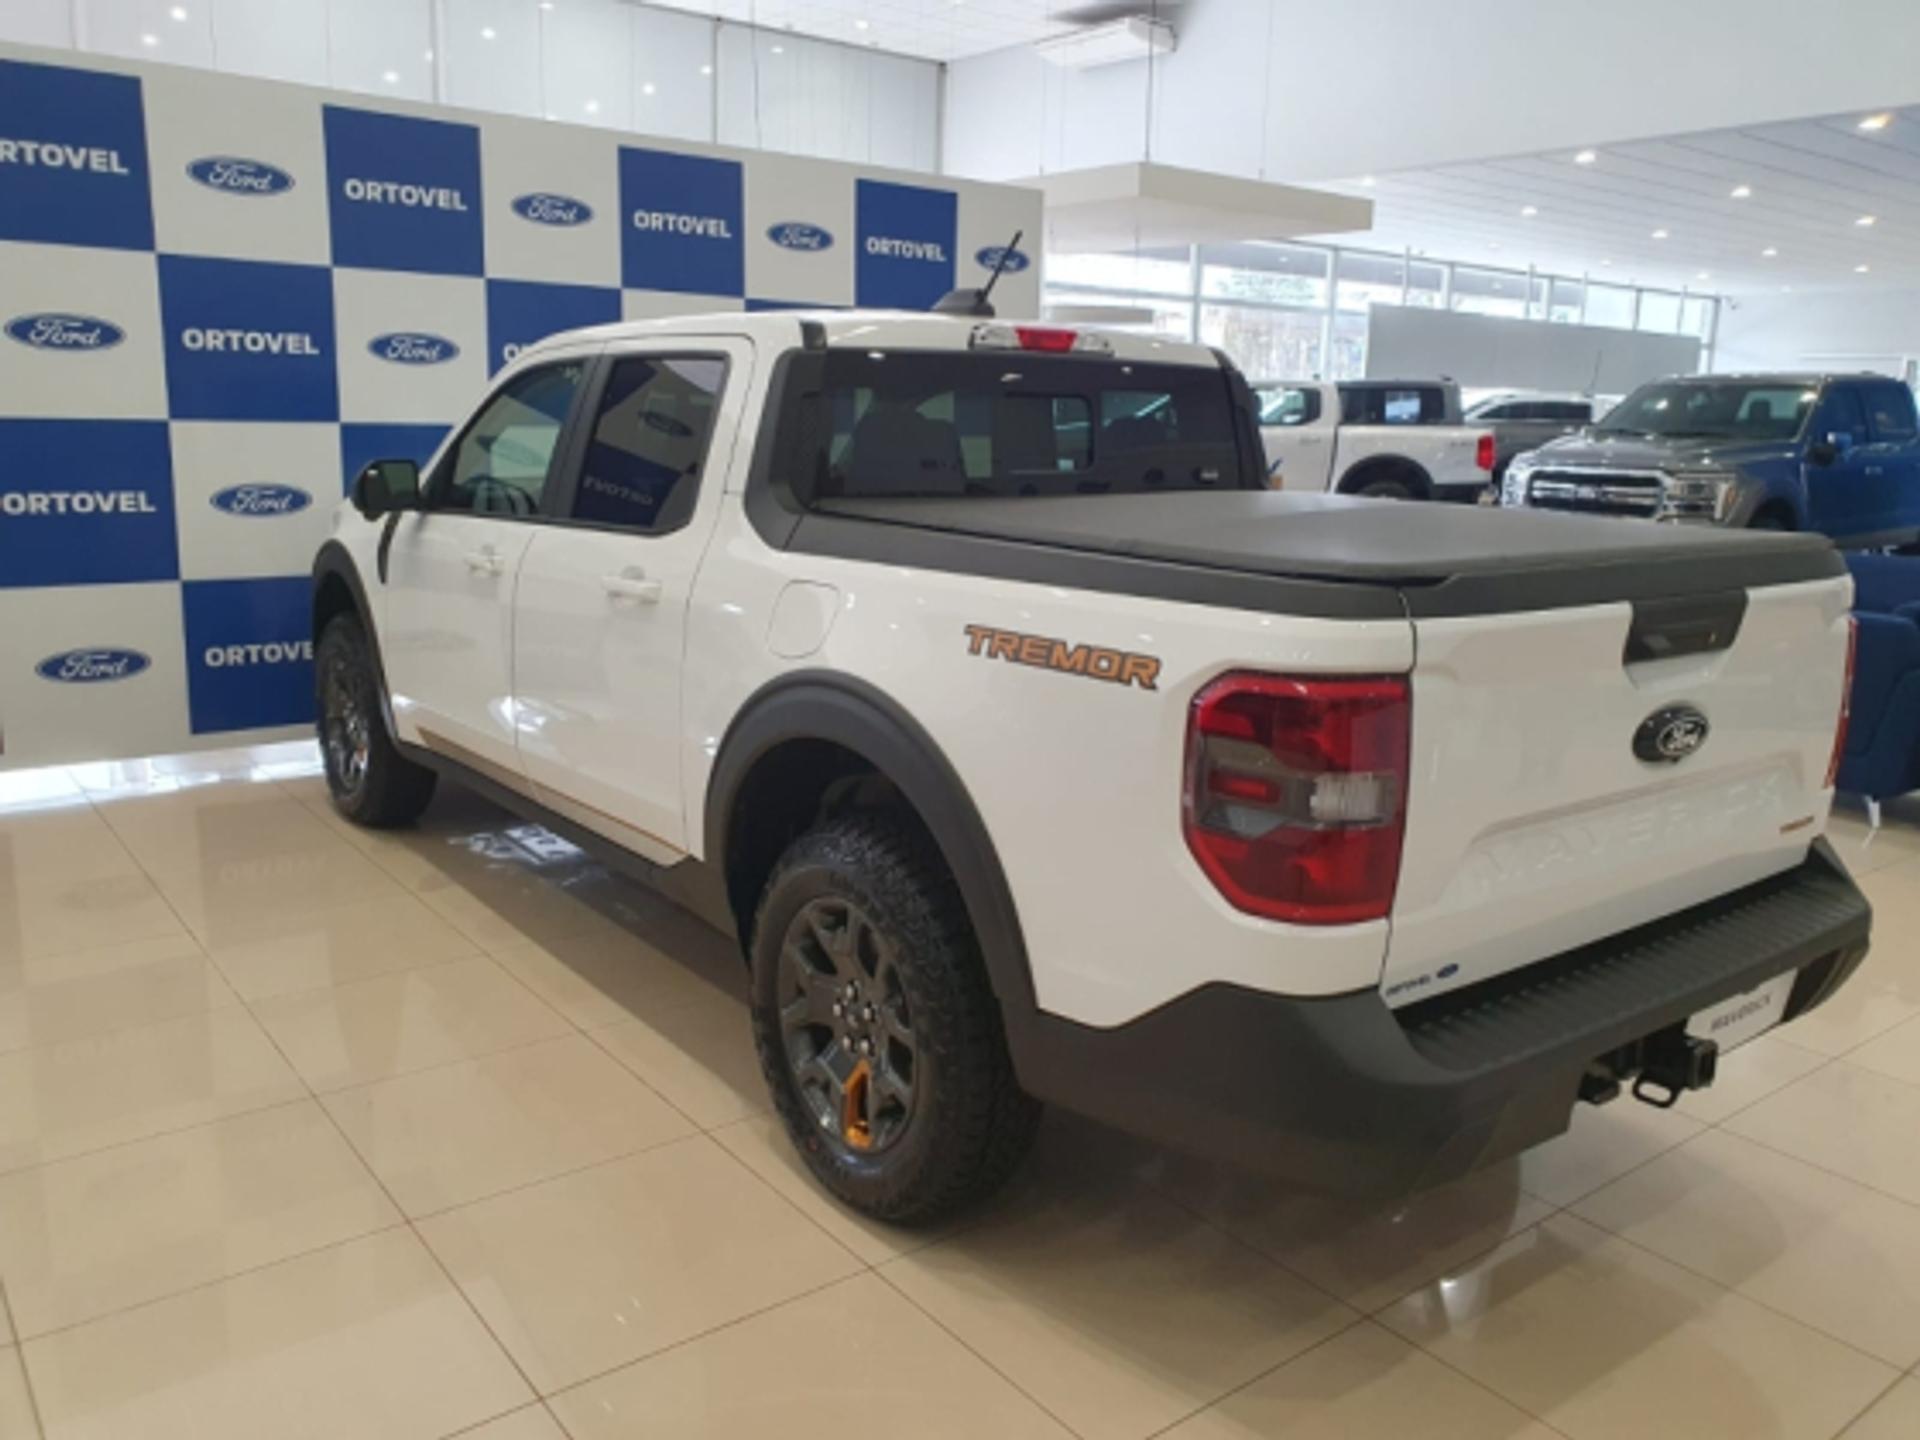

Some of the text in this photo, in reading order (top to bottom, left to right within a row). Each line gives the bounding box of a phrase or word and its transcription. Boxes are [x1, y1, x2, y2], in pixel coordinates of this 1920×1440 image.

[0, 139, 129, 174] RTOVEL
[207, 160, 274, 191] Ford
[344, 178, 467, 211] ORTOVEL
[527, 196, 579, 223] Ford
[633, 209, 732, 239] ORTOVEL
[778, 224, 822, 249] Ford
[866, 236, 947, 262] ORTOVEL
[28, 318, 101, 346] Ford
[182, 328, 320, 355] ORTOVEL
[386, 334, 443, 361] Ford
[1, 491, 156, 515] ORTOVEL
[229, 486, 294, 513] Ford
[58, 651, 129, 681] Ford
[204, 641, 313, 667] ORTOVE
[964, 624, 1162, 691] TREMOR
